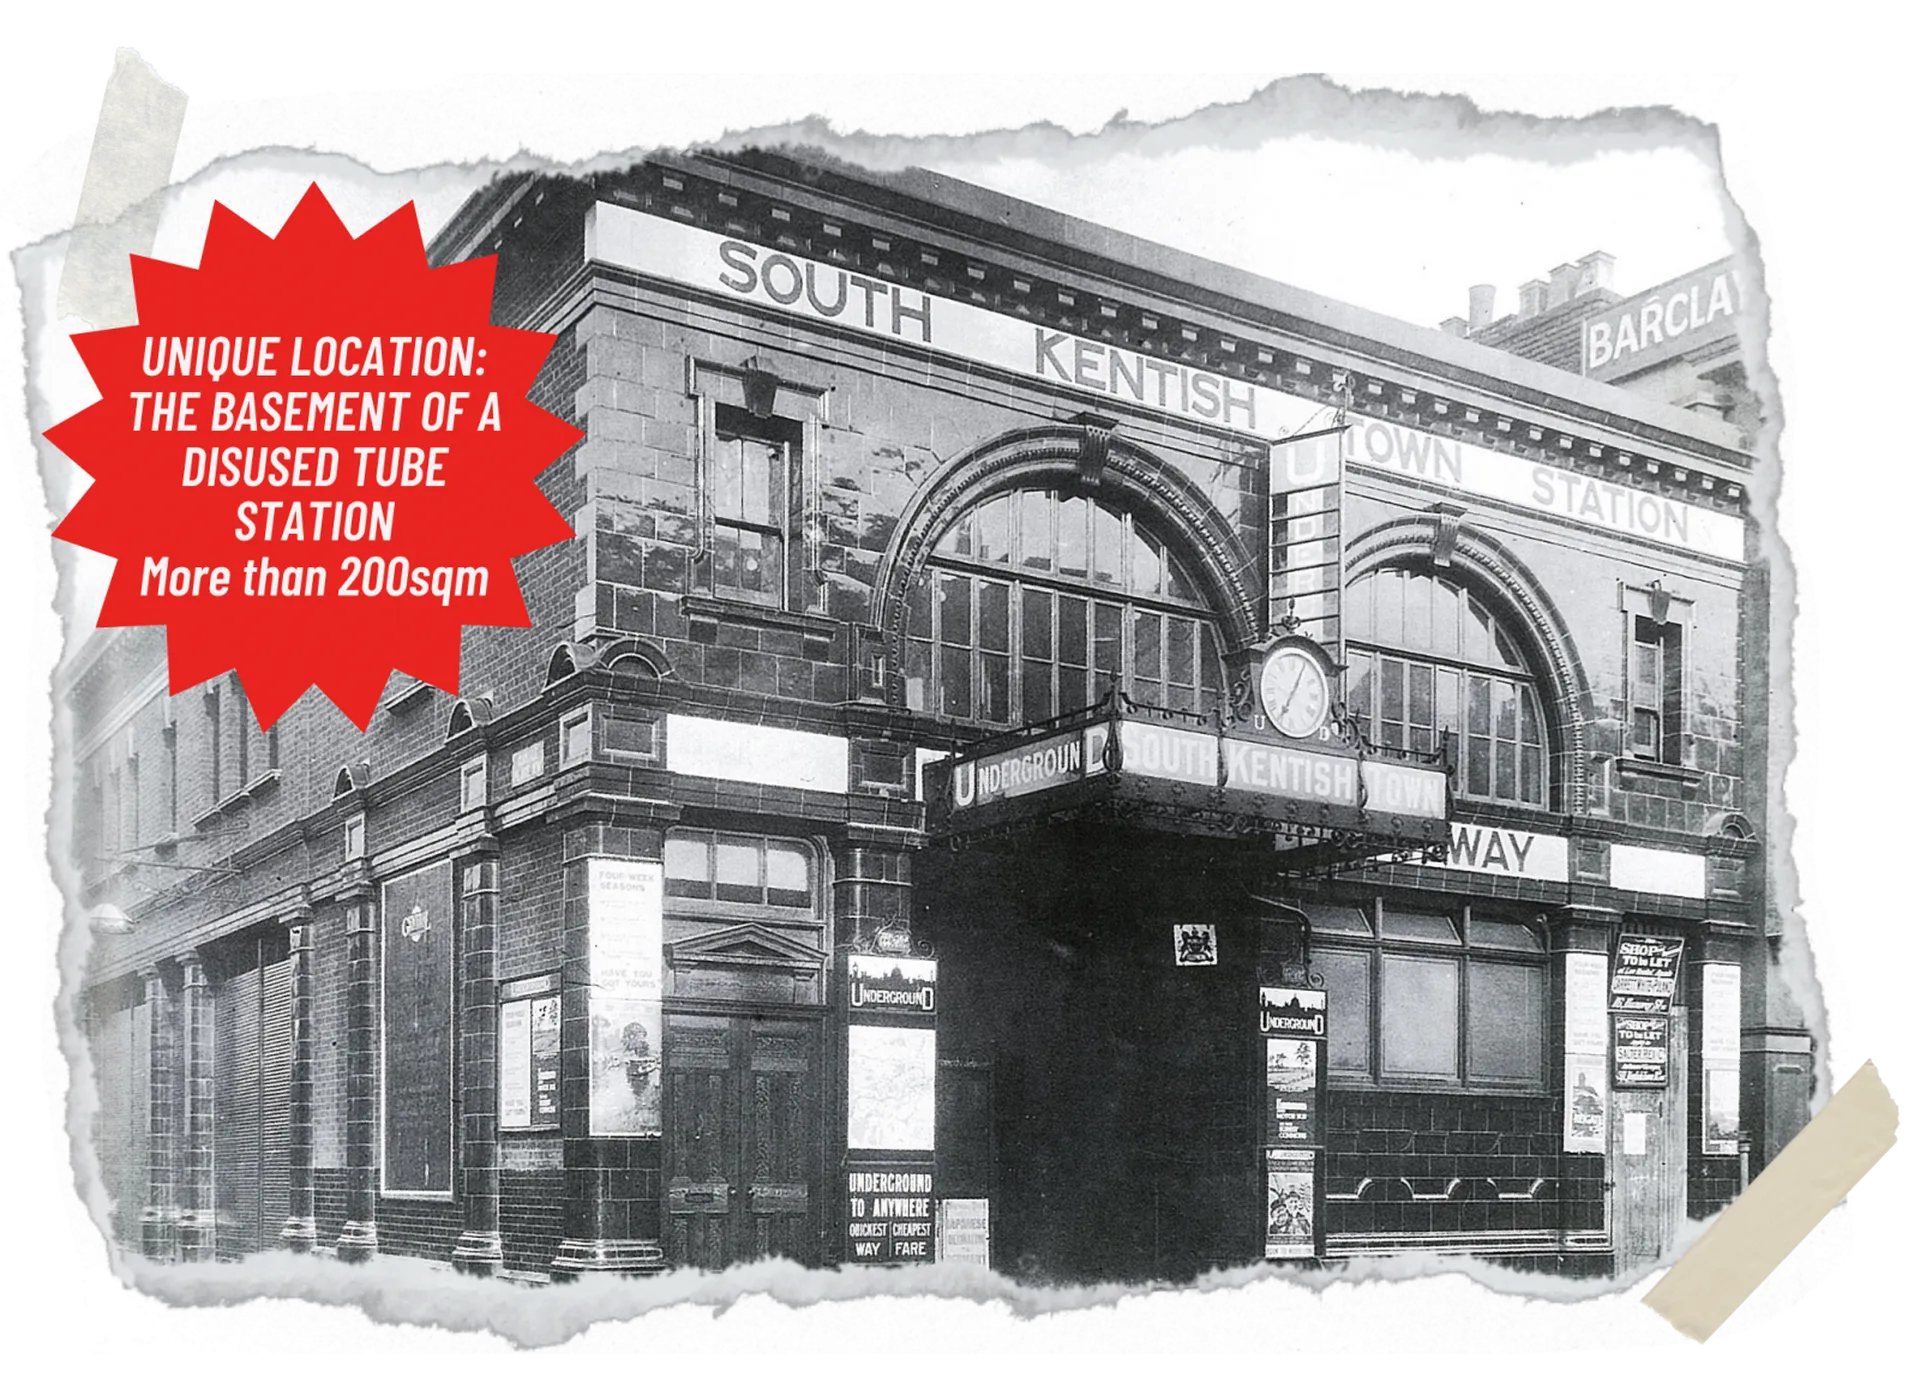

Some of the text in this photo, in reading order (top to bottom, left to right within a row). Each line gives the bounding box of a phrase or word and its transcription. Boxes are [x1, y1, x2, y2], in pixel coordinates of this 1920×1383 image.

[719, 241, 1688, 544] SOUTH KENTISH TOWN STATION
[954, 727, 1109, 806] UNDERGROUND
[1122, 726, 1439, 814] SOUTH KENTISH TOWN
[628, 872, 655, 882] WEEK
[600, 881, 646, 892] SEASONS
[1619, 942, 1658, 957] SHOP
[1622, 955, 1638, 966] TO
[1649, 957, 1673, 968] LET
[600, 968, 628, 978] HAVE
[851, 982, 934, 1011] UNDERGROUND
[1260, 1010, 1324, 1036] UNDERGROUND
[1618, 1030, 1634, 1039] TO
[1644, 1031, 1663, 1040] LET
[848, 1172, 933, 1193] UNDERGROUND
[851, 1198, 865, 1218] TO
[872, 1198, 930, 1218] ANYWHERE
[849, 1222, 888, 1237] QUICKEST
[892, 1222, 932, 1237] CHEAPEST
[855, 1242, 881, 1257] WAY
[895, 1242, 927, 1256] FARE
